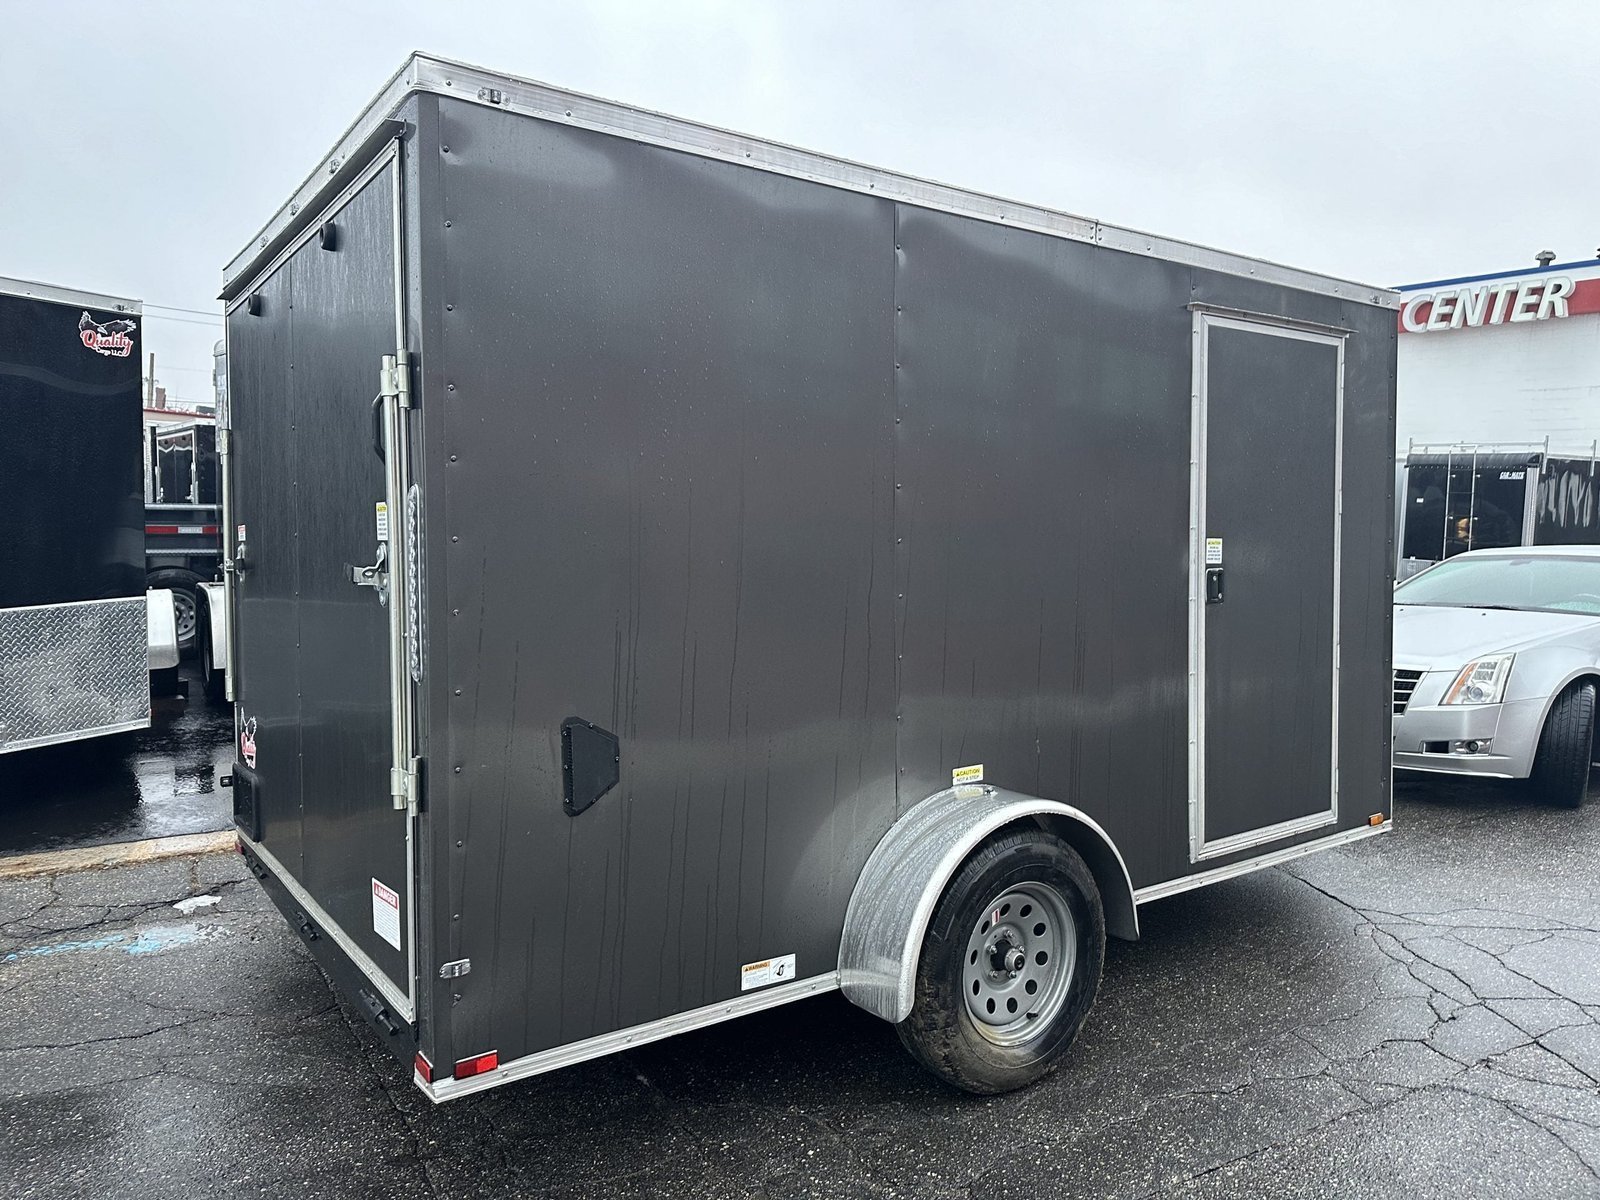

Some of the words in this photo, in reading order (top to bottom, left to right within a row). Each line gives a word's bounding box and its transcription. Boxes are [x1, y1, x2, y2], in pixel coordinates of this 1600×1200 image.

[1402, 276, 1575, 333] CENTER
[80, 330, 133, 357] Quality
[960, 768, 980, 776] CAUTION
[748, 962, 768, 971] WARNING
